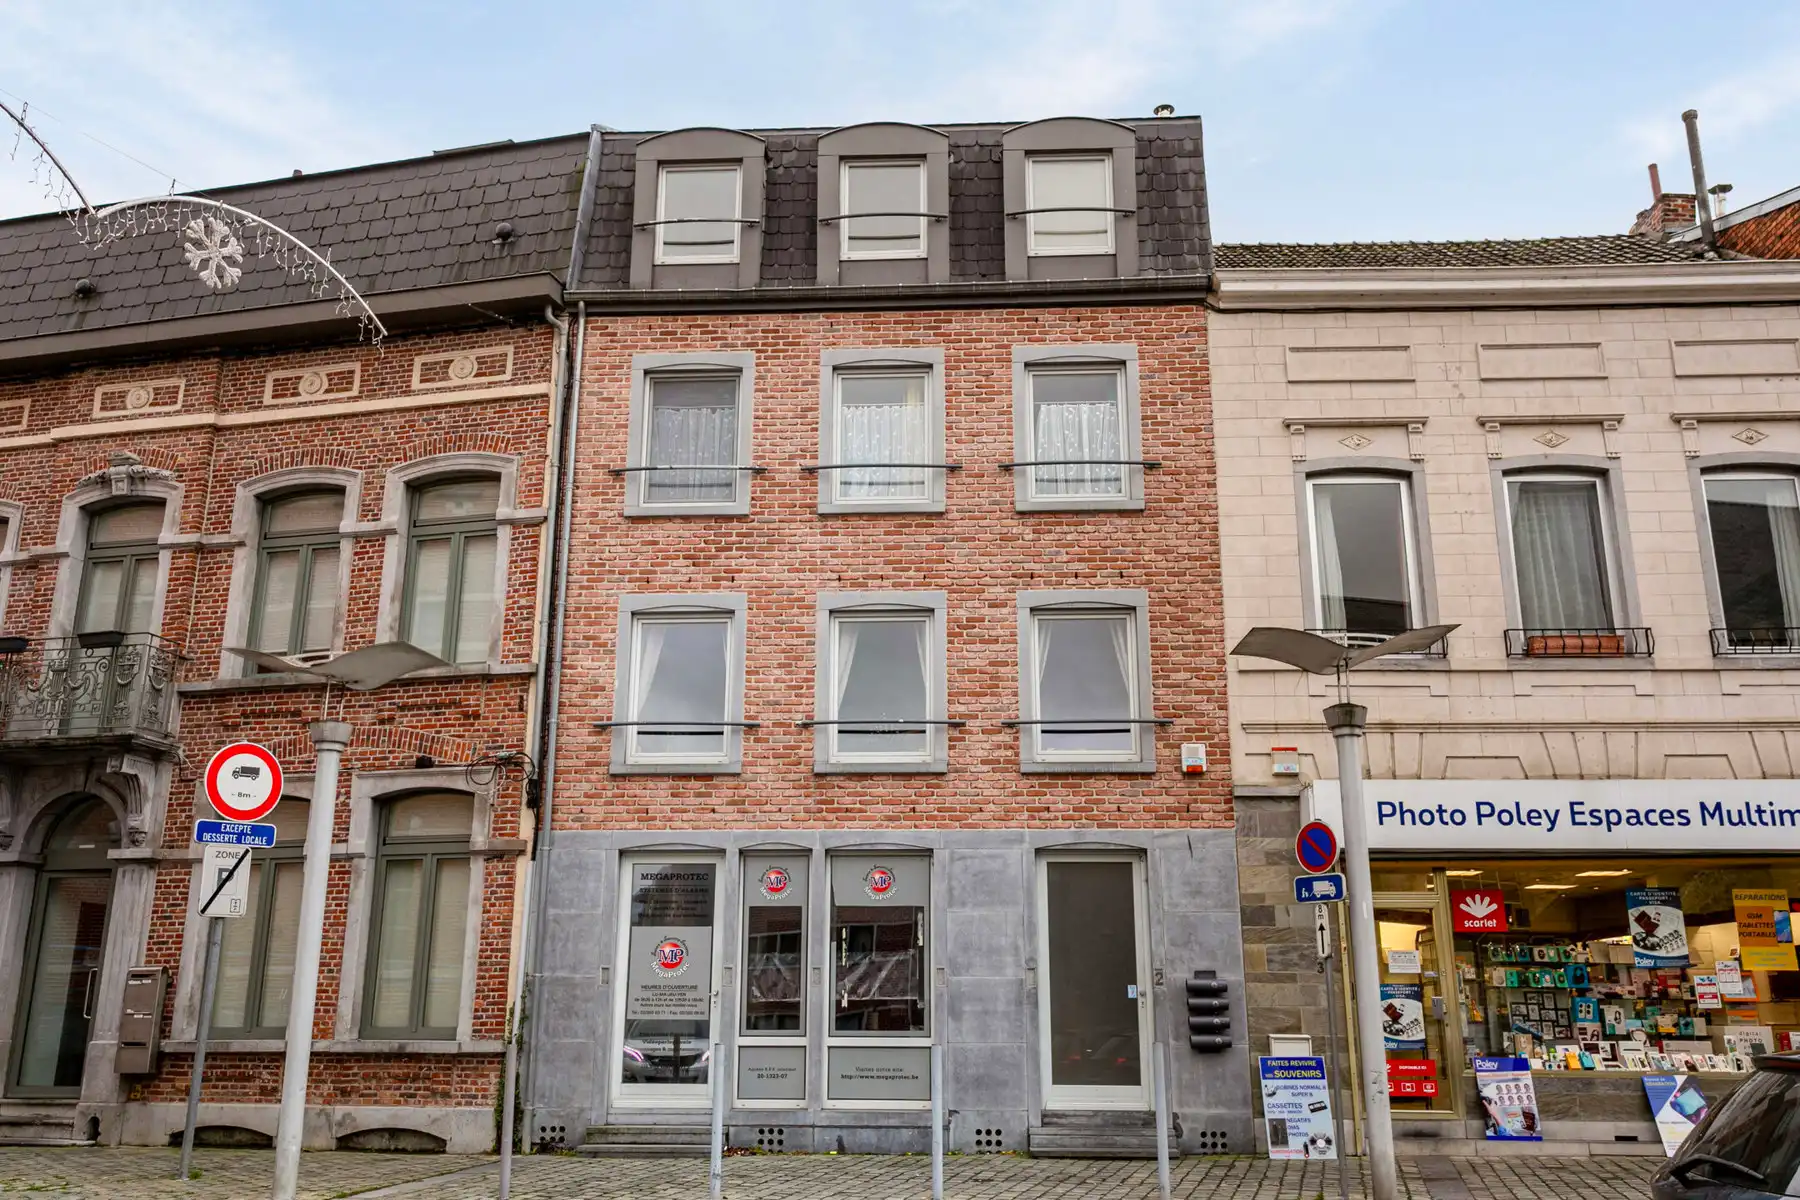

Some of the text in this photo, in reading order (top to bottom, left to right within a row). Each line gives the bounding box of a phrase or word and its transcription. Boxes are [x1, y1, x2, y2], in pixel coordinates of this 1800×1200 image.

[237, 791, 251, 799] 8m
[1377, 801, 1467, 826] Photo
[1476, 801, 1560, 832] Poley
[1569, 801, 1691, 832] Espaces
[221, 823, 252, 834] EXCEPTE
[203, 832, 267, 845] DESSERTE LOCALE
[215, 850, 241, 860] ZONE
[640, 872, 709, 881] MEGAPROTEC
[759, 886, 793, 900] MegaProtec
[863, 885, 898, 900] MegaProtec
[1317, 904, 1323, 913] 8
[1464, 918, 1497, 928] scarlet
[1739, 930, 1777, 938] PORTABLES
[658, 948, 684, 963] MP
[1634, 957, 1655, 966] Poley
[650, 961, 690, 978] MegaProtec
[1316, 962, 1324, 974] 3
[1475, 1060, 1498, 1070] Poley
[1274, 1069, 1322, 1078] SOUVENIRS
